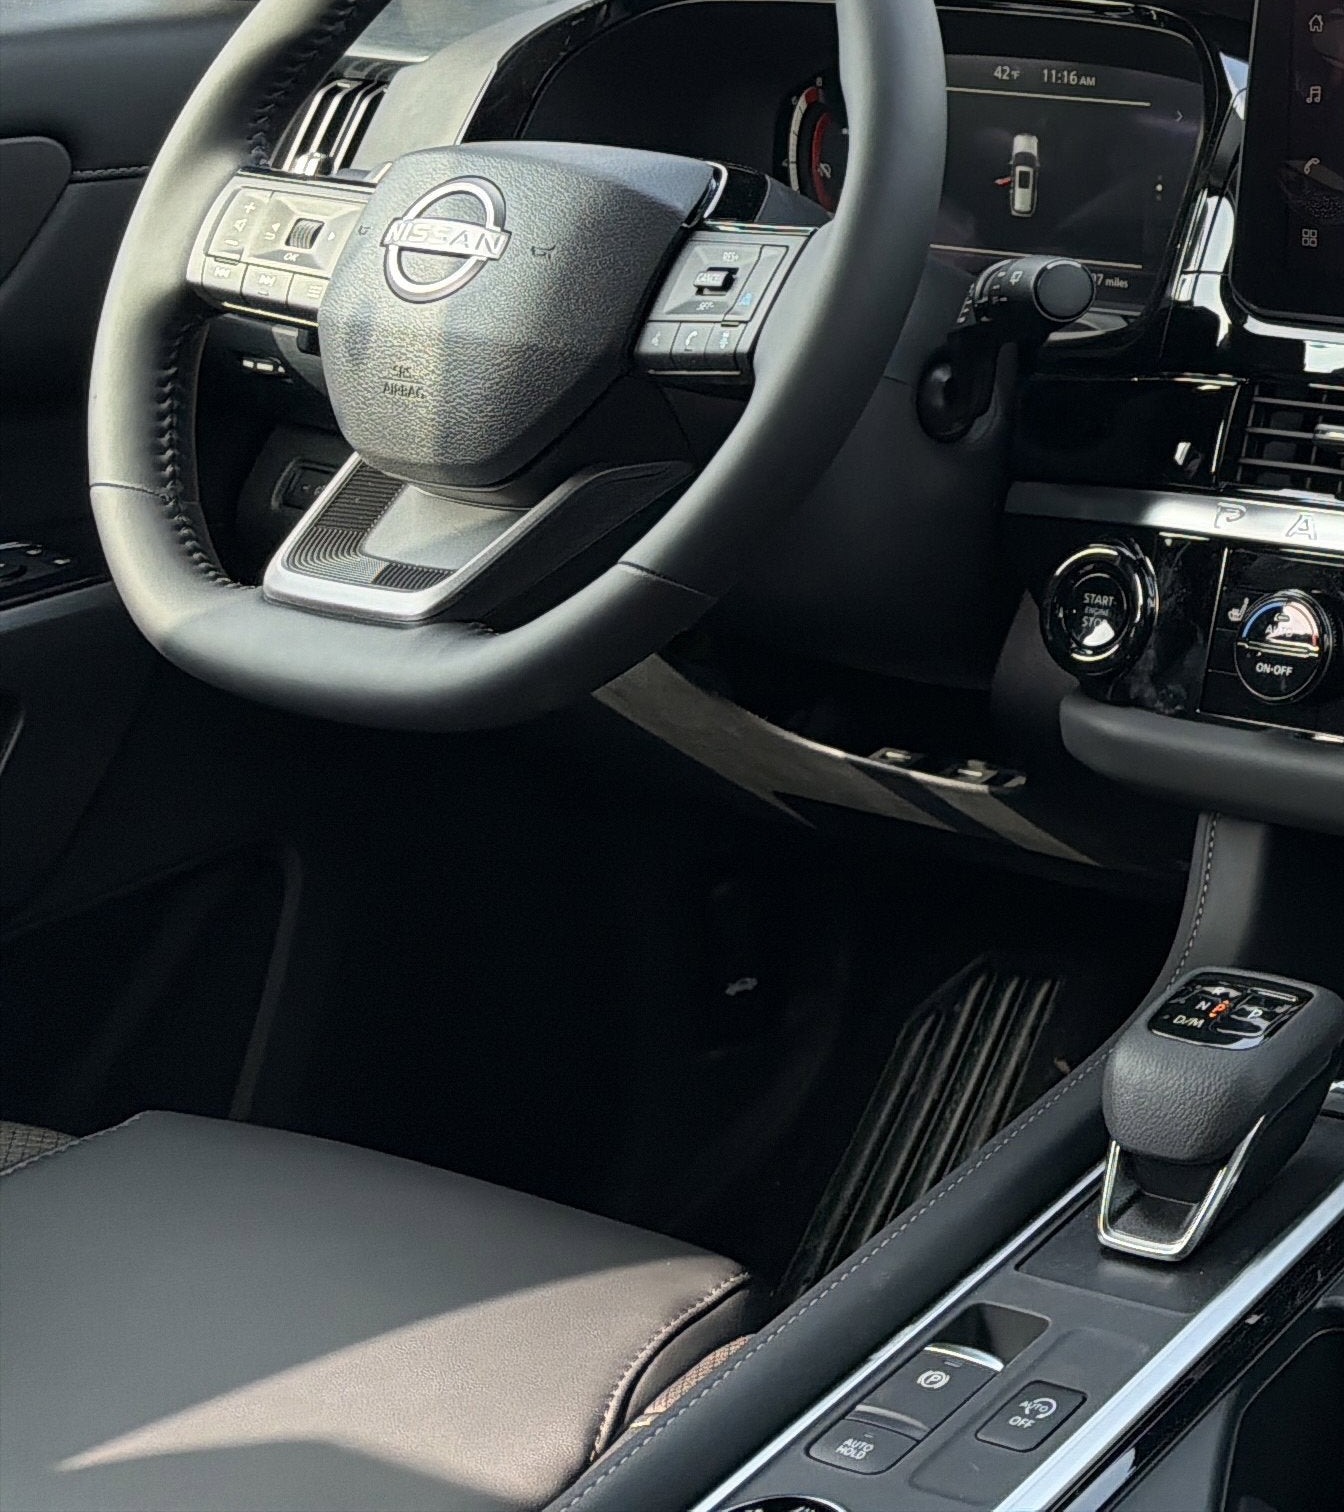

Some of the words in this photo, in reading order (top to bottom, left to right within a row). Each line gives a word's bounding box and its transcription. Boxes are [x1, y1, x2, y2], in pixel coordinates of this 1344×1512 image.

[1042, 68, 1078, 85] 11:16
[1079, 75, 1096, 87] AM
[388, 221, 506, 255] NISSAN
[283, 252, 299, 262] OK
[1105, 277, 1129, 289] miles
[1083, 593, 1114, 606] START
[1194, 1000, 1211, 1011] N
[1248, 1008, 1263, 1019] P
[1172, 1014, 1205, 1029] D/M
[1018, 1399, 1049, 1414] AUTO
[1008, 1415, 1036, 1429] OFF
[842, 1438, 874, 1452] AUTO
[835, 1446, 867, 1460] HOLD
